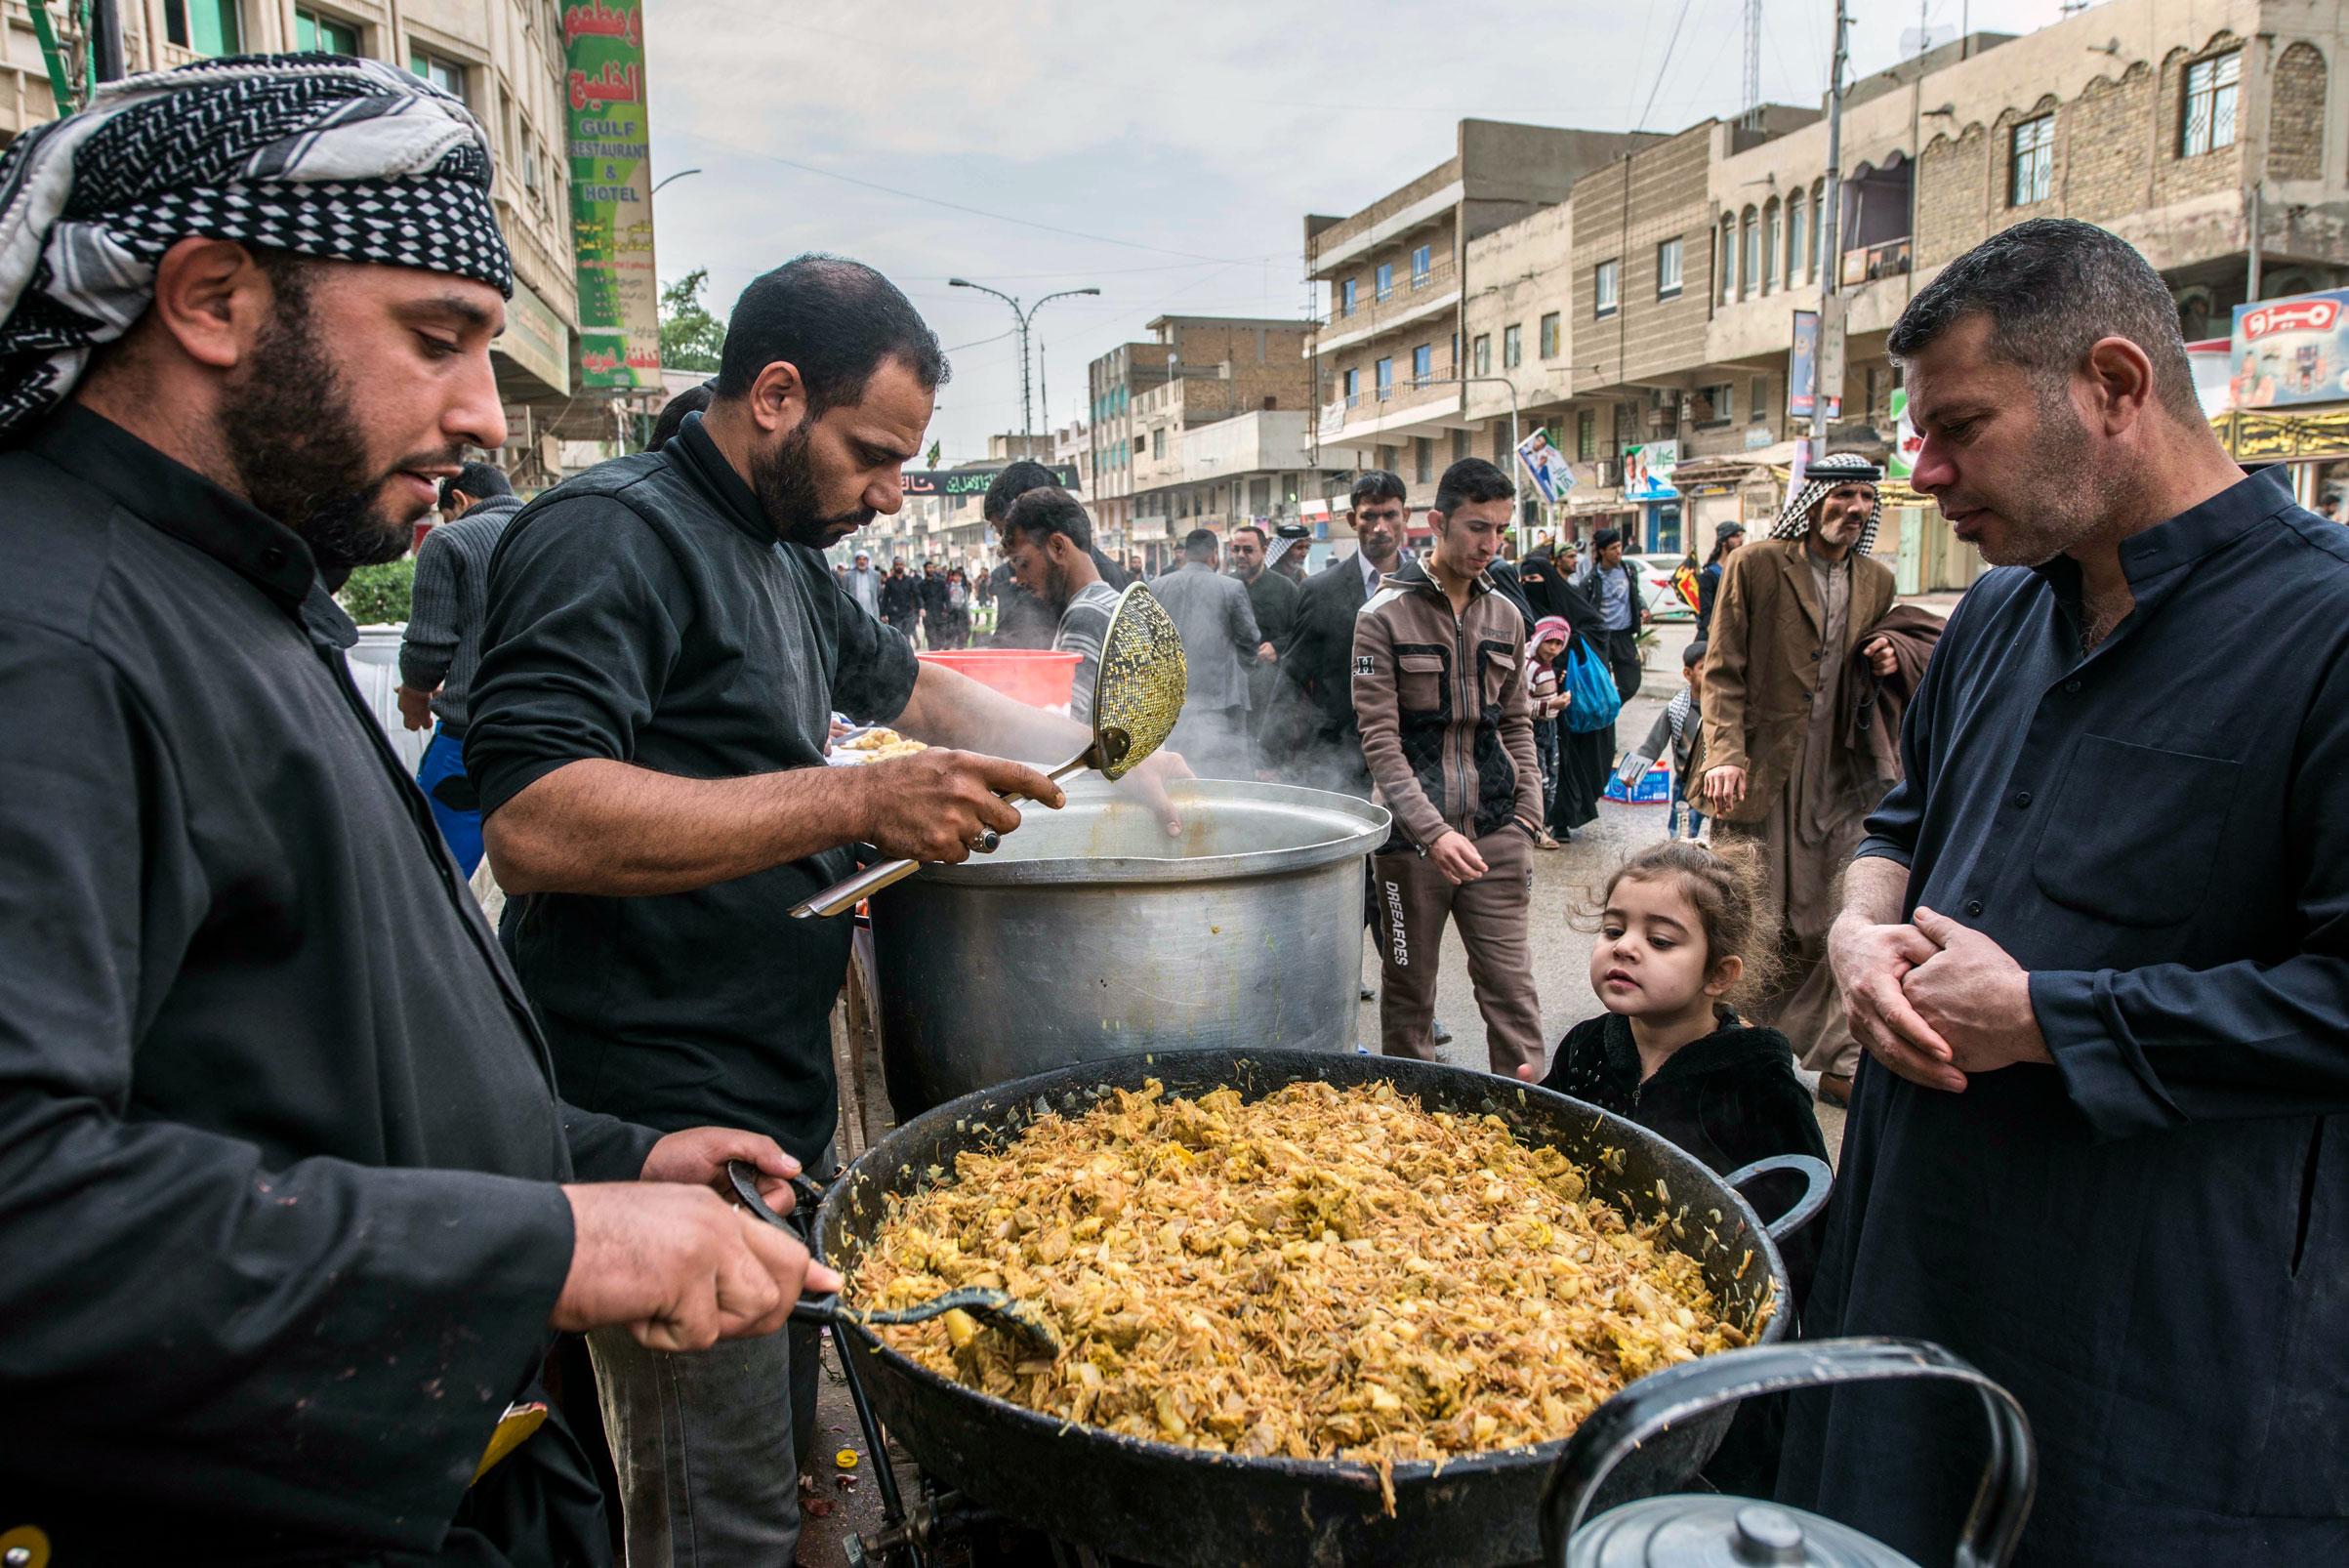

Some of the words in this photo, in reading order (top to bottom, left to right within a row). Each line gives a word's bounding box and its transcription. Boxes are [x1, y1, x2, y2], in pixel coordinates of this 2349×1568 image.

[564, 0, 640, 49] ومطعم
[569, 60, 641, 111] الخليج
[580, 119, 636, 136] GULF
[605, 164, 617, 180] &
[584, 185, 640, 203] HOTEL
[2248, 304, 2331, 336] ميزو
